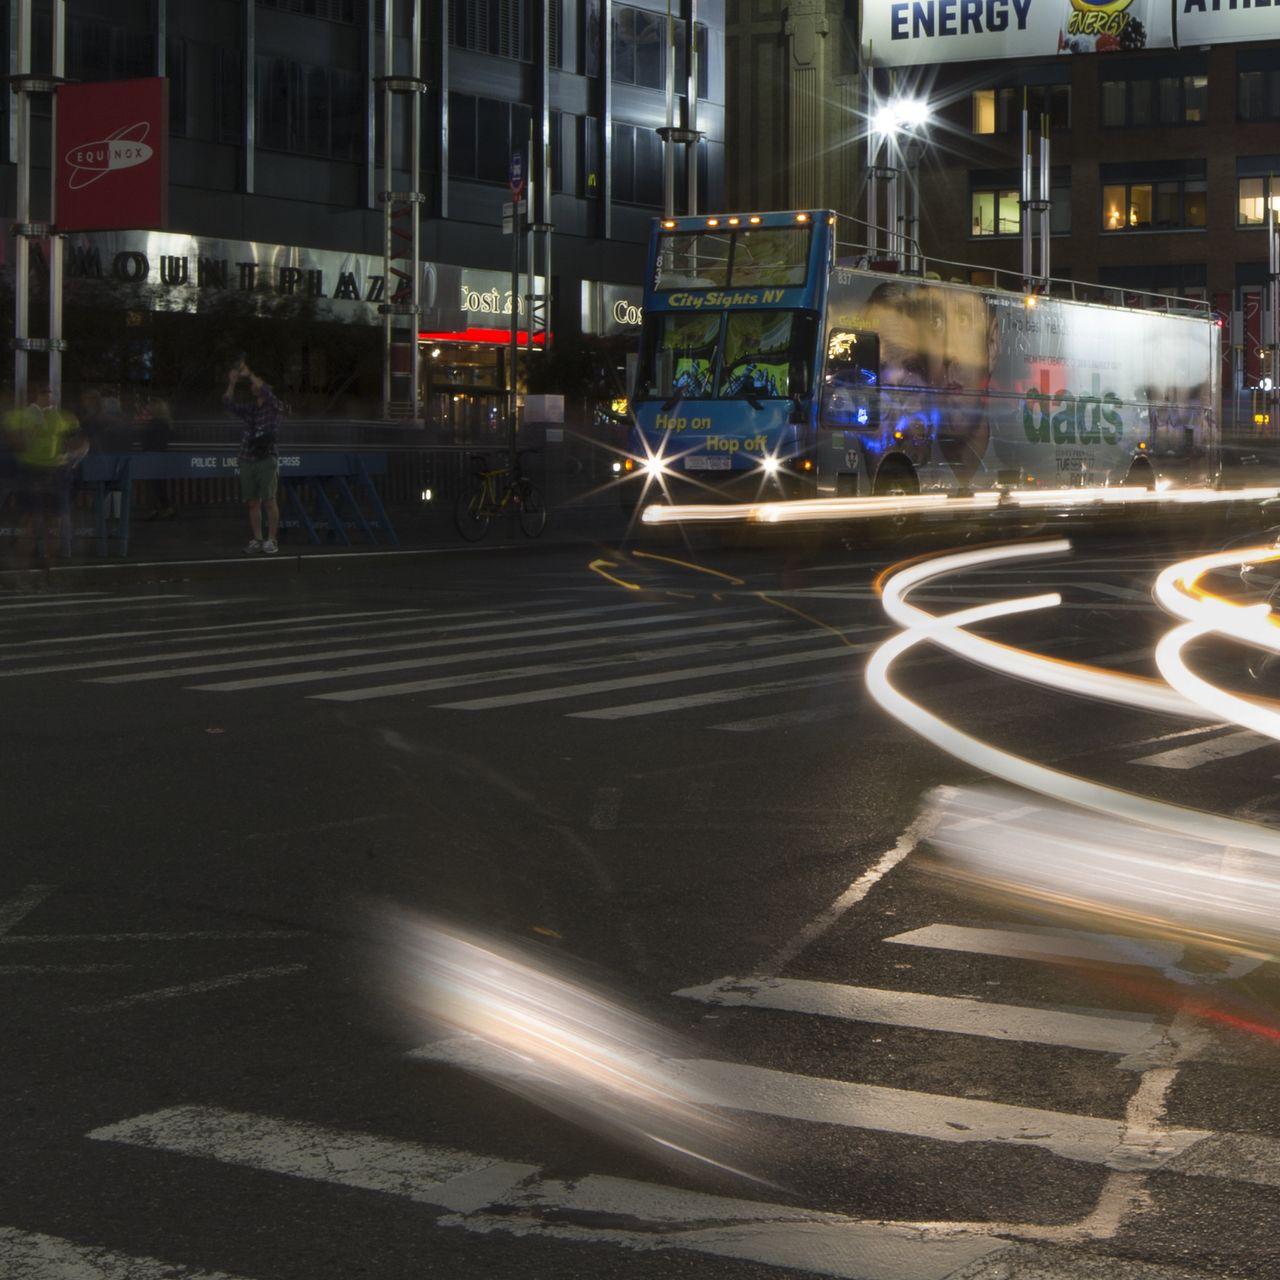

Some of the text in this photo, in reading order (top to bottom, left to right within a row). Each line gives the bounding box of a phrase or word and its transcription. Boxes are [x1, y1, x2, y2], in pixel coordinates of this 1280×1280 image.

[1067, 8, 1130, 37] ENERGY
[77, 147, 142, 163] EQUINOX
[761, 289, 785, 304] NY
[1023, 369, 1123, 446] dads
[655, 414, 711, 431] Hop on
[706, 435, 768, 452] Hop off
[191, 457, 217, 468] POLICE
[222, 457, 240, 468] LINE
